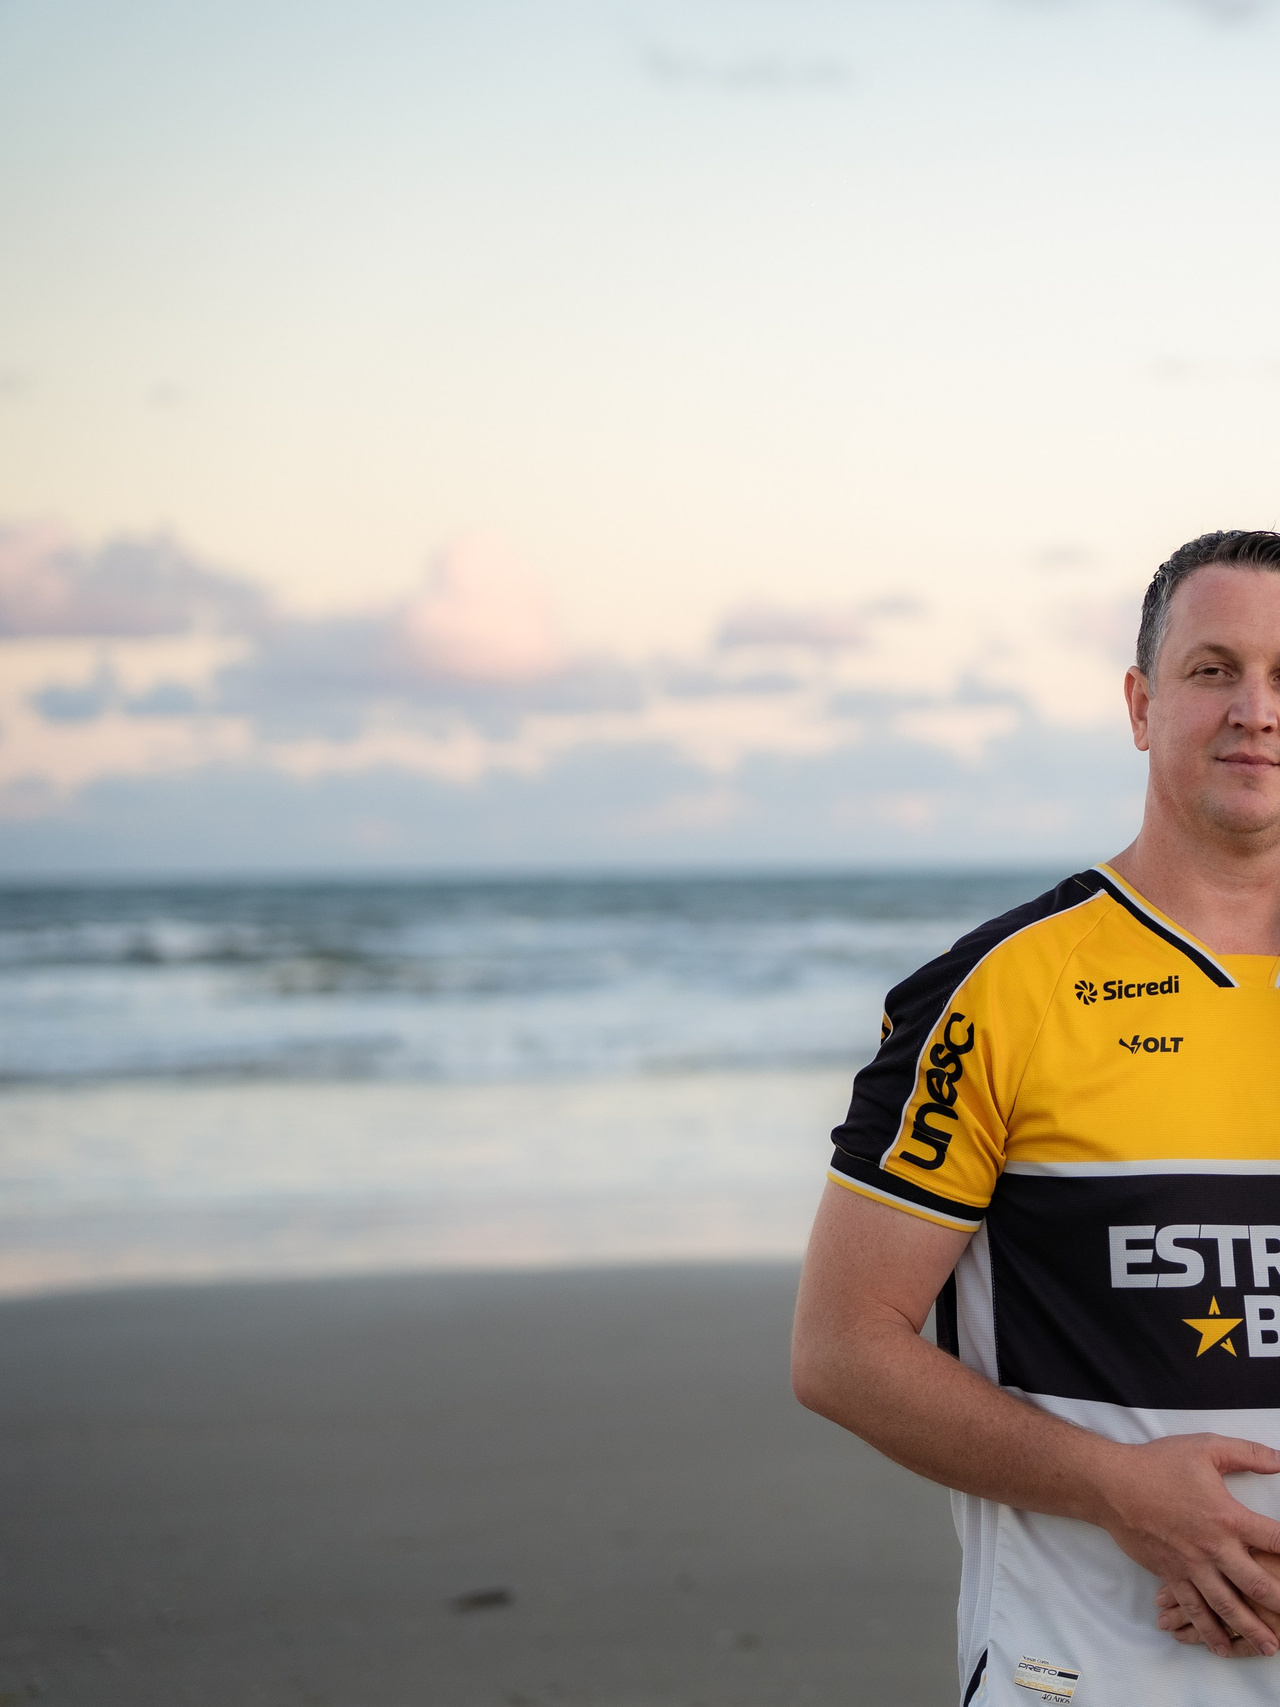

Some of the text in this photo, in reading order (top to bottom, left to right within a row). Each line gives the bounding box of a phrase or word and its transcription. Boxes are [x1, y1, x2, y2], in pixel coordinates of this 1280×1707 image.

[1103, 975, 1180, 1001] Sicredi
[898, 1011, 975, 1171] unesc
[1018, 1662, 1058, 1676] PRETO
